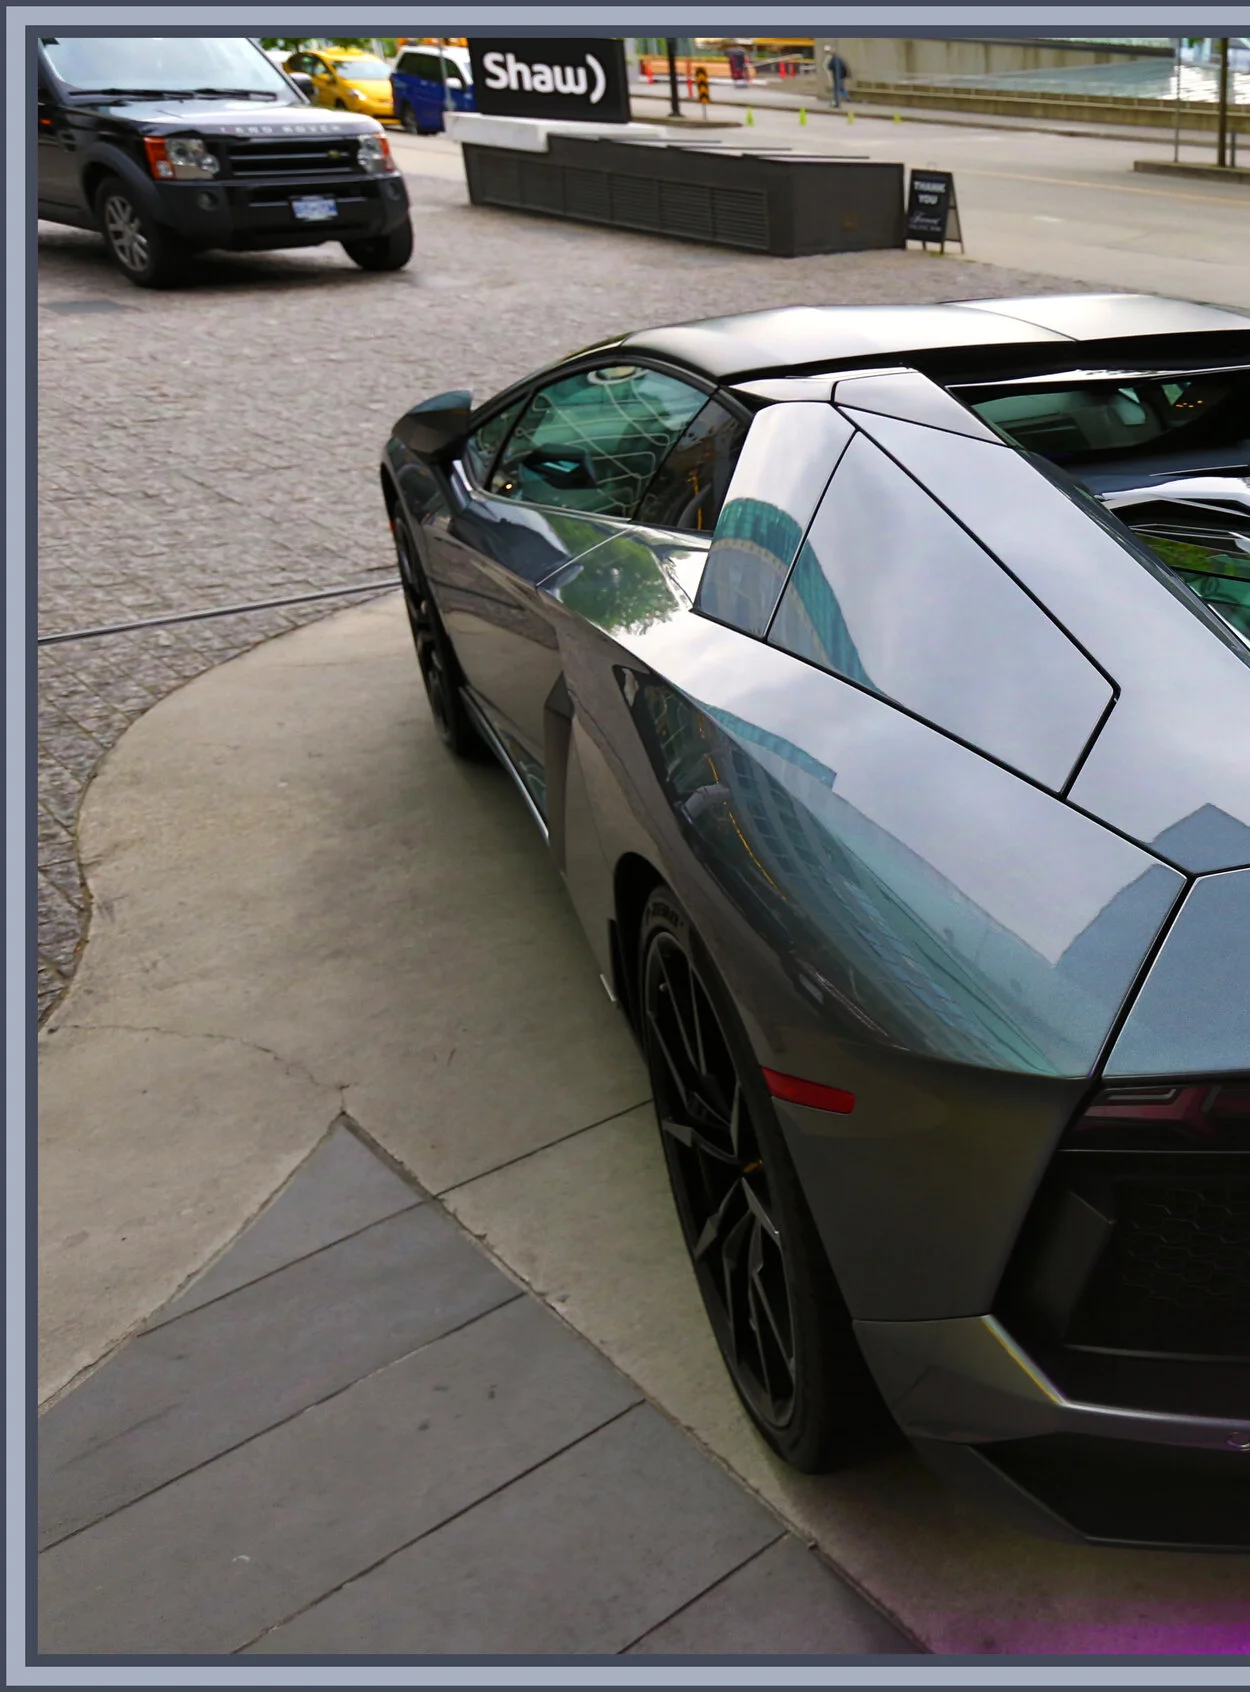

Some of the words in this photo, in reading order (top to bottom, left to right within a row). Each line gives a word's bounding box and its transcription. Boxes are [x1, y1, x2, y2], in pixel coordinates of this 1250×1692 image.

[282, 125, 341, 133] ROVER
[914, 181, 946, 193] THANK
[918, 194, 938, 204] YOU
